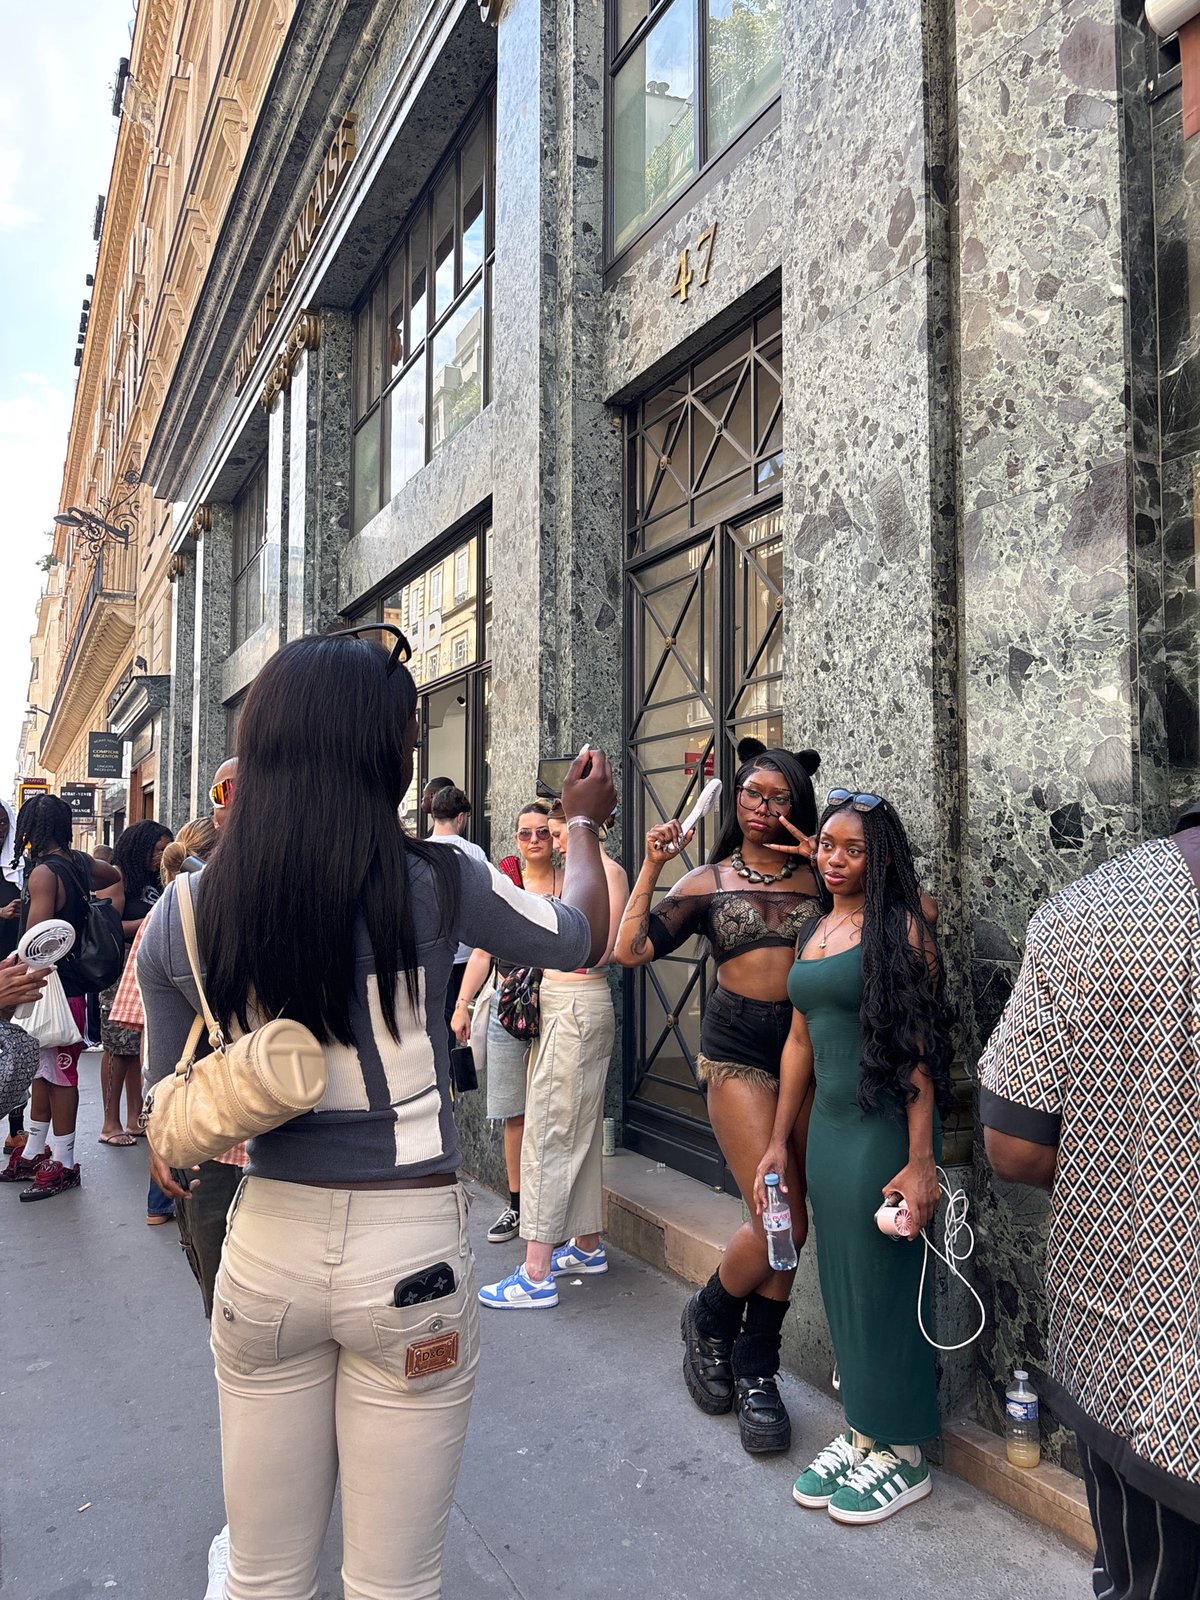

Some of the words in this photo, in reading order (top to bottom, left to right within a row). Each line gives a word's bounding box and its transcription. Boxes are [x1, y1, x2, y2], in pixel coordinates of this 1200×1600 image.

[671, 221, 718, 304] 47
[234, 284, 277, 396] BANQUE
[57, 1056, 69, 1065] 22
[422, 1347, 445, 1361] D&G
